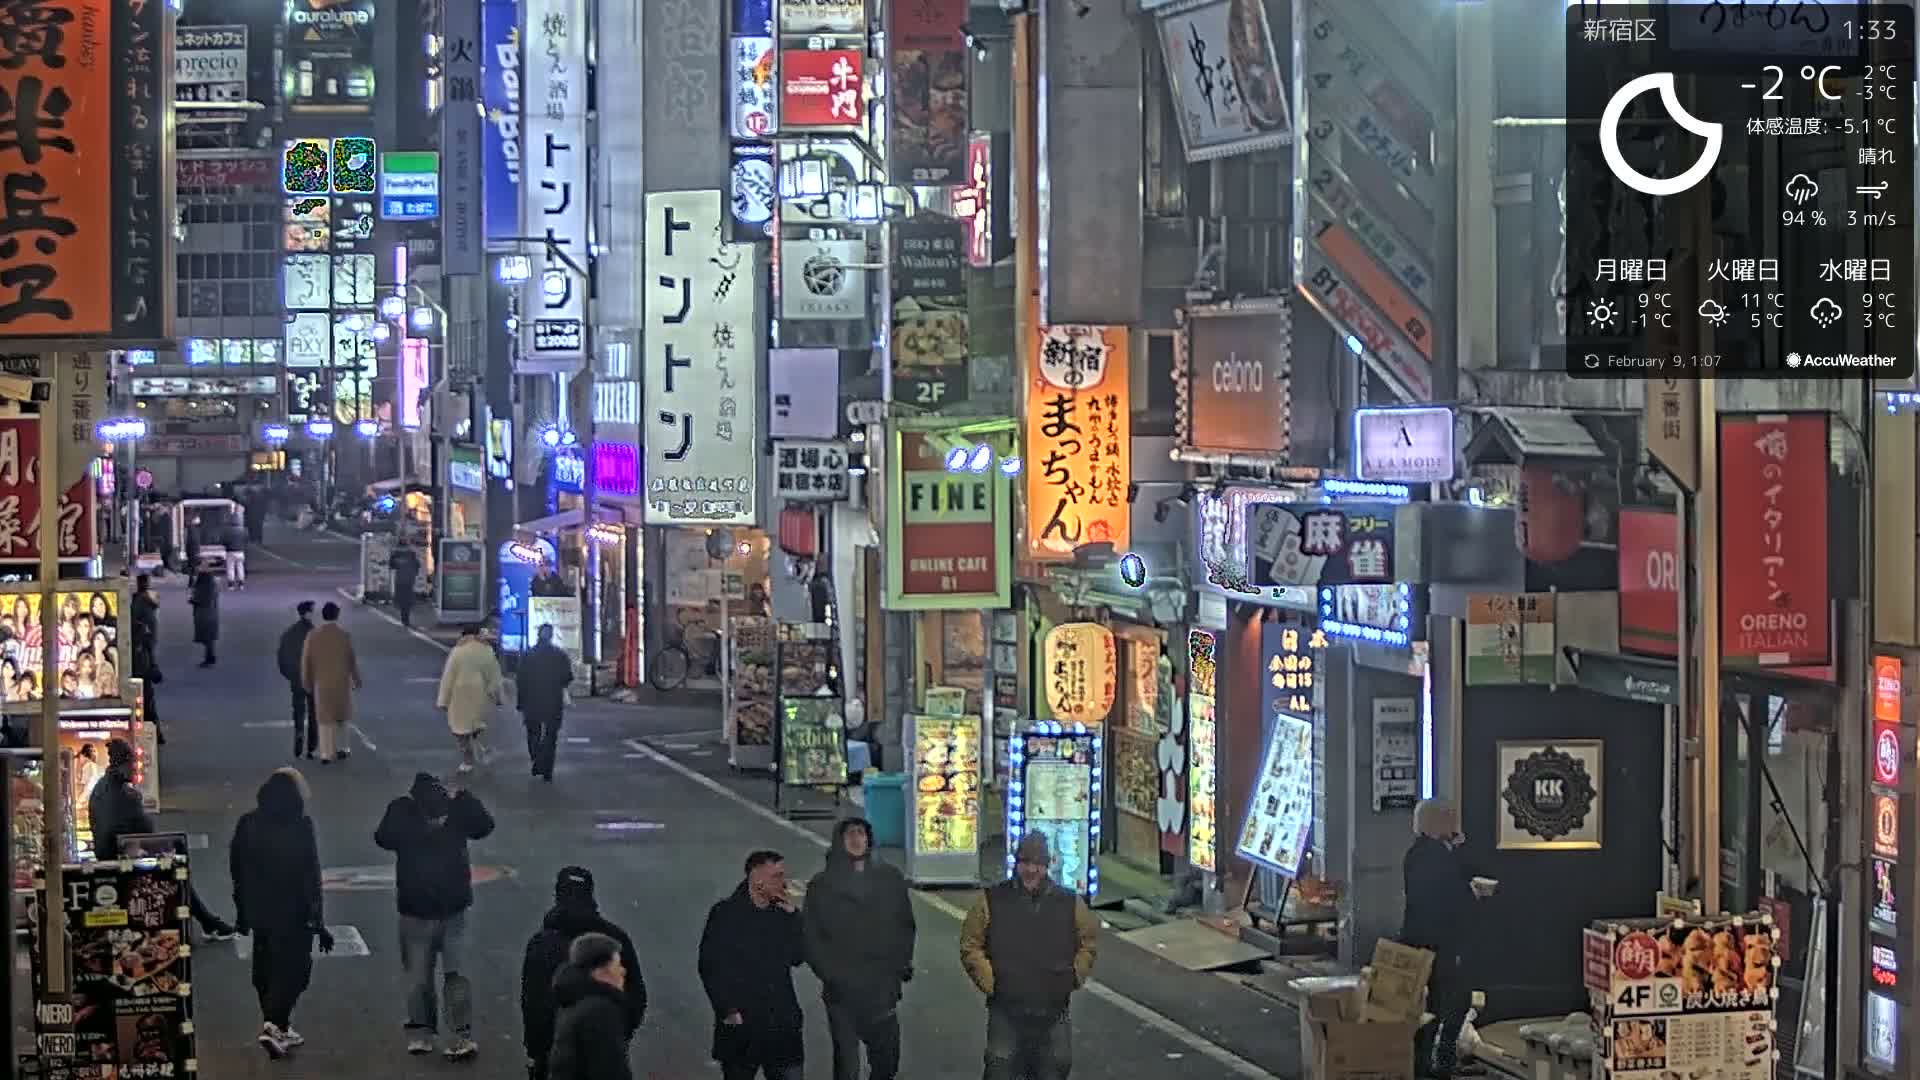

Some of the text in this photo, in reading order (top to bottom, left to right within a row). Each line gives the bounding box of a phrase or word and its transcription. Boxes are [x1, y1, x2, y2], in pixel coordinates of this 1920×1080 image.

[830, 56, 859, 119] 牛門
[659, 206, 695, 461] トントン
[916, 384, 946, 402] 2F
[779, 447, 843, 469] 酒場心
[1041, 392, 1086, 545] まっちゃん
[778, 472, 844, 491] 新宿本店
[911, 482, 986, 511] FINE
[1349, 517, 1390, 533] フリー
[1753, 429, 1788, 601] 俺のイタリアン
[1302, 513, 1389, 578] 麻雀
[957, 557, 989, 573] CAFE
[1647, 552, 1679, 591] OR
[1740, 613, 1807, 631] ORENO
[1738, 631, 1808, 649] ITALIAN
[1535, 779, 1564, 796] KK
[1617, 985, 1651, 1008] 4F
